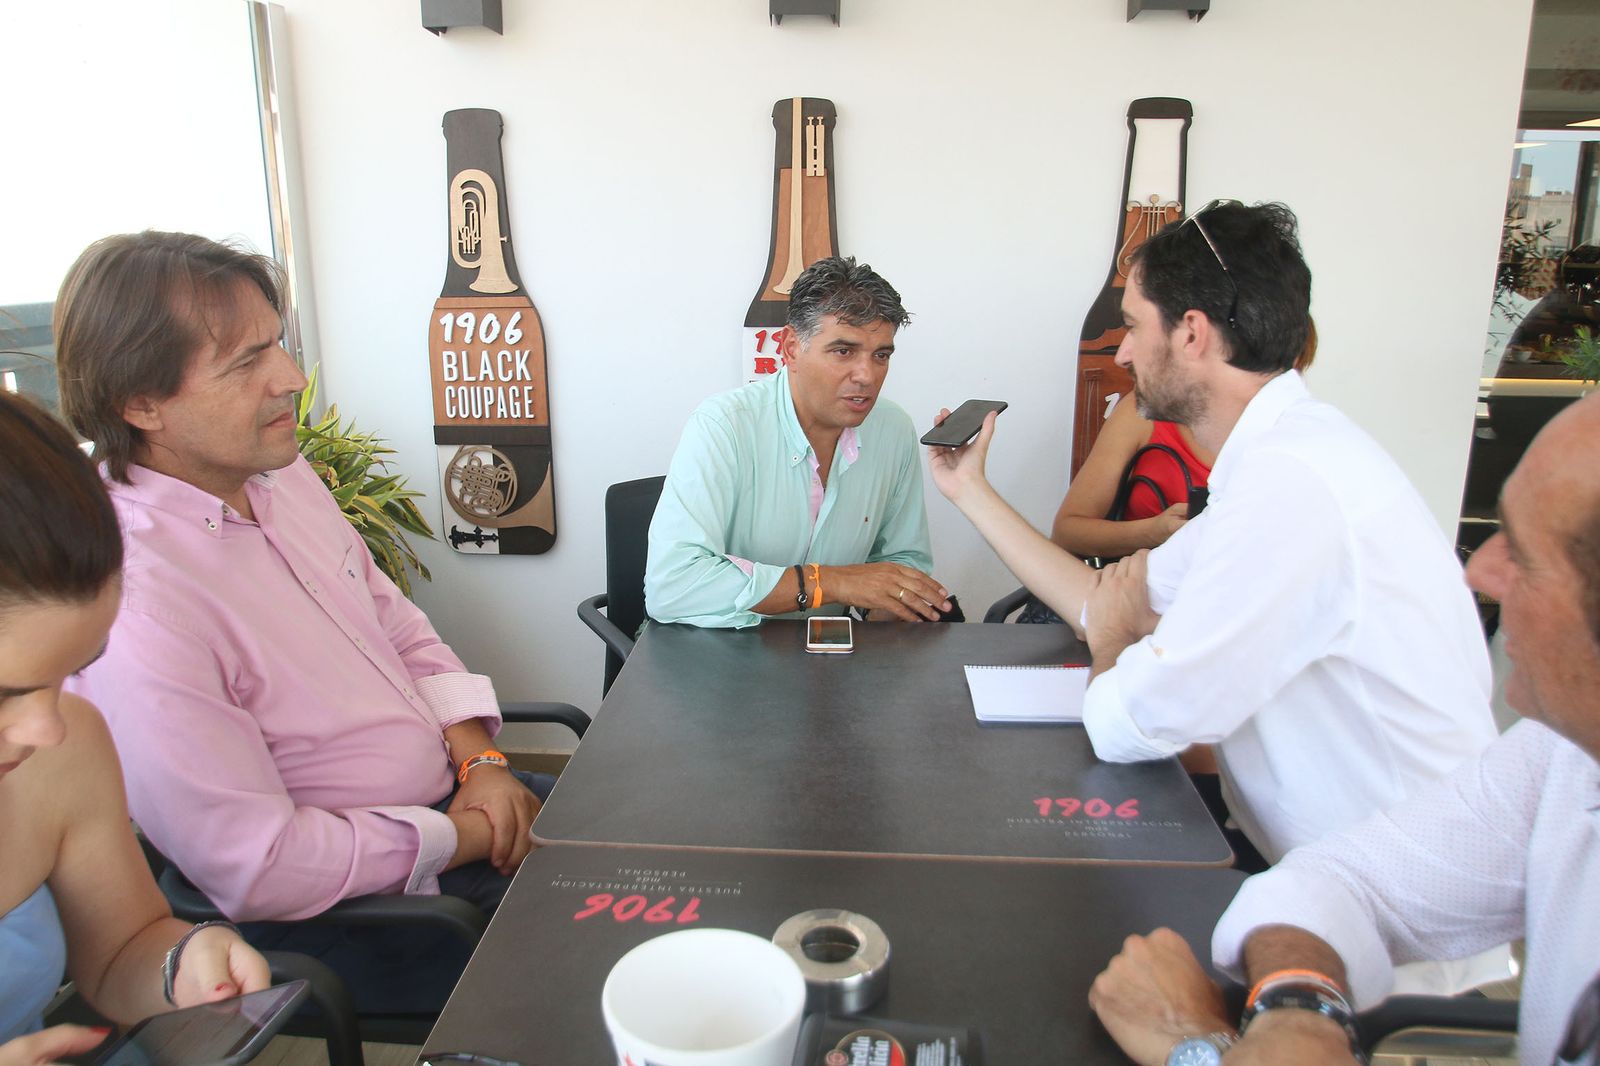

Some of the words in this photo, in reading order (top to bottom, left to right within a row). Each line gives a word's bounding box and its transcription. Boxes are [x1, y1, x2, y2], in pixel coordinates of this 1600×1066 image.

[440, 311, 523, 345] 1906
[755, 329, 787, 355] 19
[442, 350, 532, 382] BLACK
[445, 385, 535, 419] COUPAGE
[1033, 797, 1140, 818] 1906
[1006, 817, 1064, 825] NUESTRA
[1064, 830, 1133, 839] PERSONAL
[617, 868, 687, 878] PERSONAL
[679, 886, 742, 896] NUESTRA
[573, 892, 701, 924] 1906
